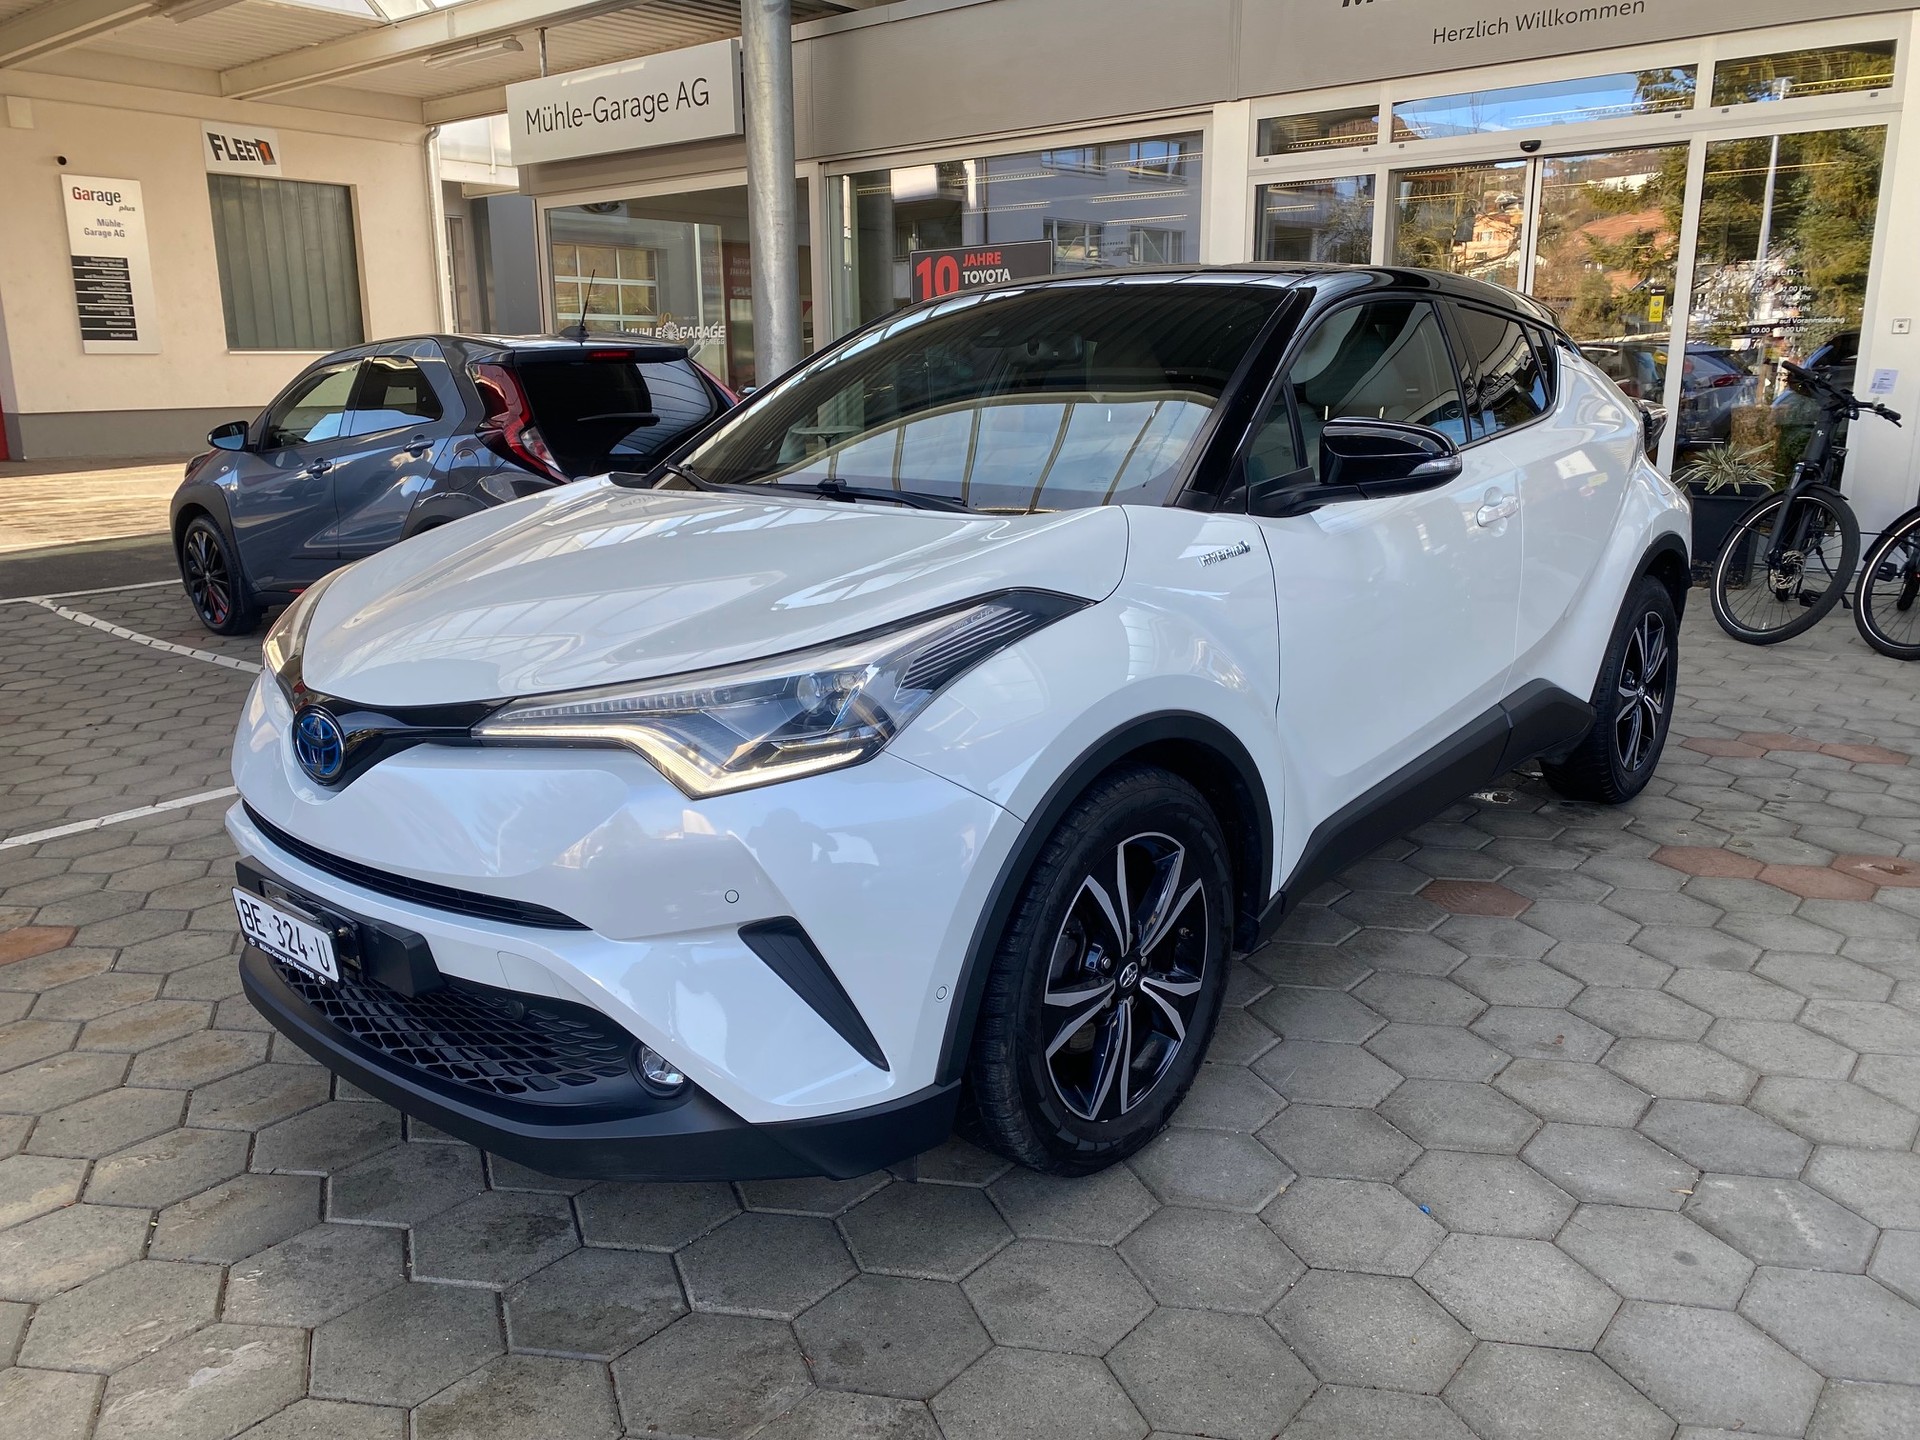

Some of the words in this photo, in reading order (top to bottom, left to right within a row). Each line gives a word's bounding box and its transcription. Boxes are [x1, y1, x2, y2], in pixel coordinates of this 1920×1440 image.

[1433, 17, 1509, 45] Herzlich
[1516, 1, 1645, 32] Willkommen
[526, 91, 669, 135] Mühle-Garage
[675, 78, 710, 111] AG
[72, 186, 121, 206] Garage
[119, 204, 136, 212] plus
[96, 218, 124, 228] Mühle-
[84, 227, 112, 238] Garage
[113, 229, 126, 238] AG
[963, 252, 1002, 267] JAHRE
[916, 255, 959, 301] 10
[963, 268, 1011, 285] TOYOTA
[680, 325, 726, 339] GARAGE
[240, 898, 267, 938] BE
[273, 914, 309, 961] 324
[315, 937, 330, 972] U
